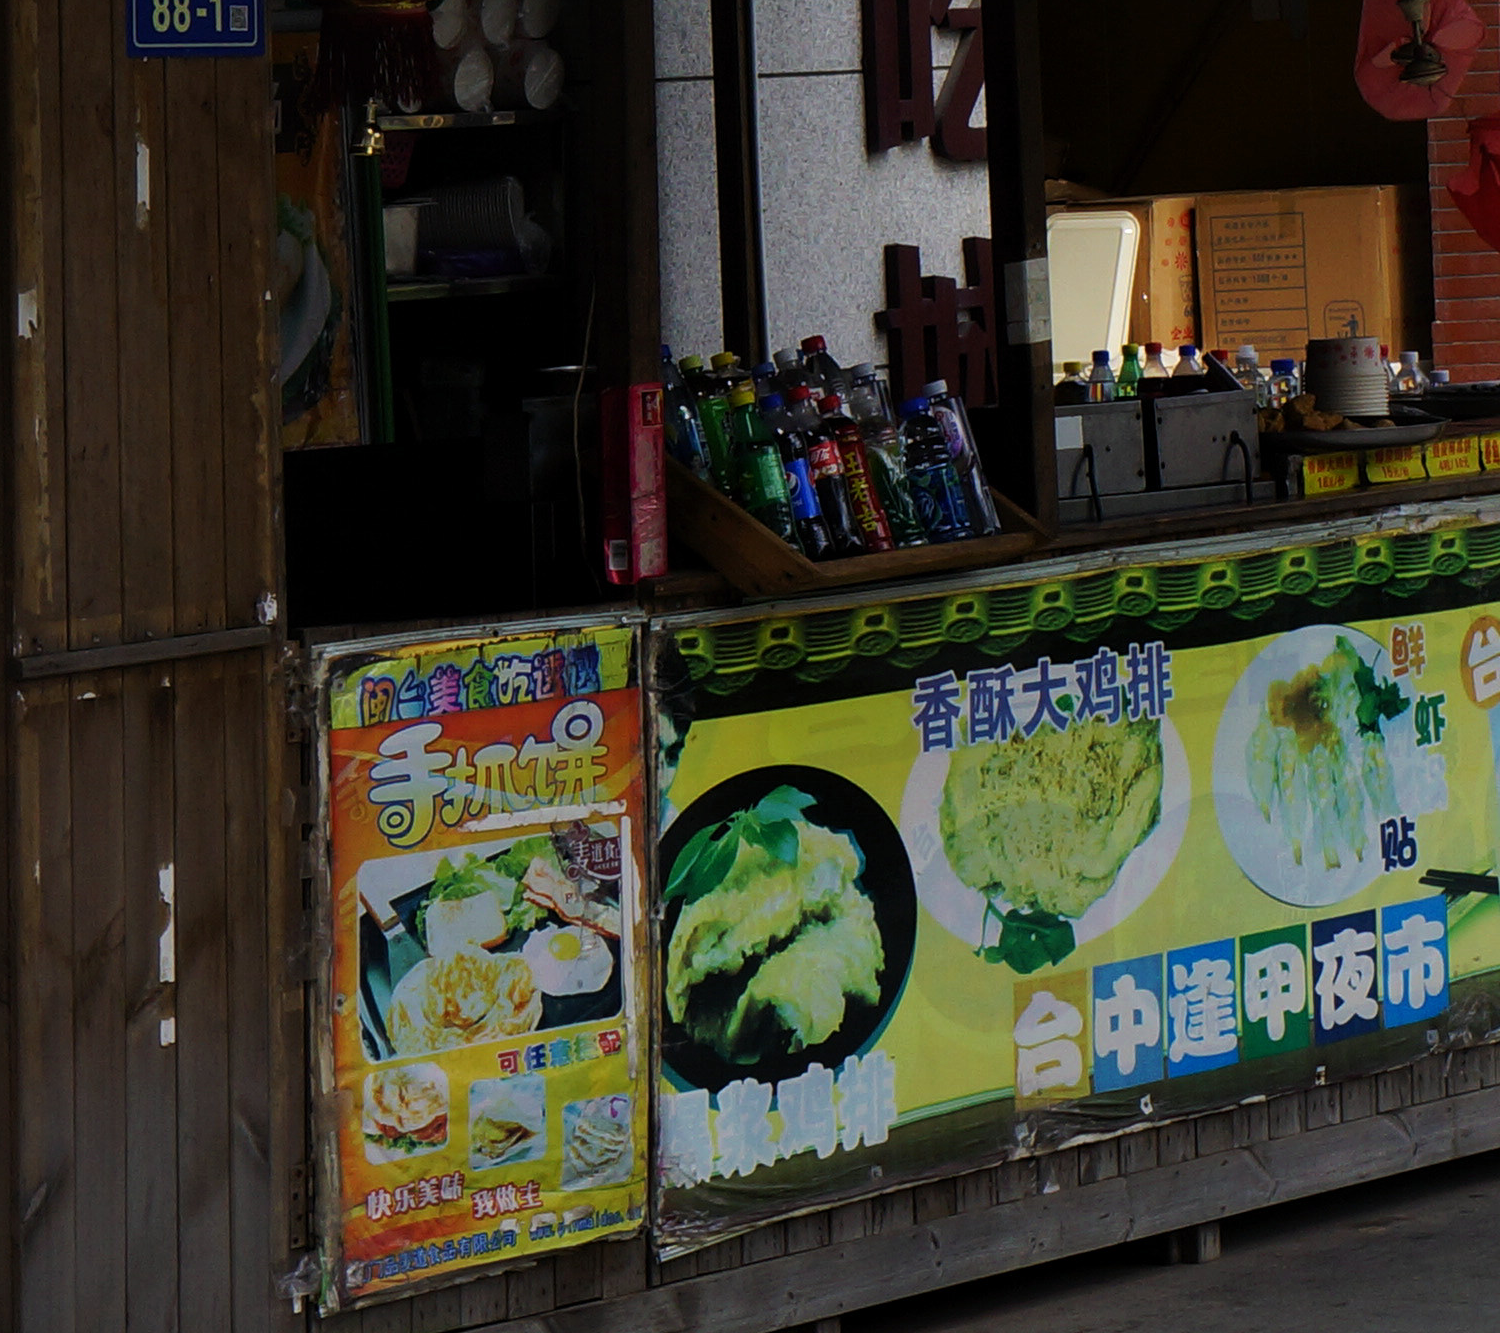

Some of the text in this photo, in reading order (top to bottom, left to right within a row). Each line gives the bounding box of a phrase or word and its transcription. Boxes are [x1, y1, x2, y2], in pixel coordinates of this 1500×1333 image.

[843, 450, 879, 532] 王老吉
[912, 641, 1173, 753] 香酥大鸡排
[1379, 623, 1448, 874] 鲜虾贴
[368, 700, 609, 849] 手抓饼
[1013, 913, 1448, 1098] 台中逢甲夜市
[366, 1171, 465, 1221] 快乐美味
[471, 1182, 543, 1219] 我做主
